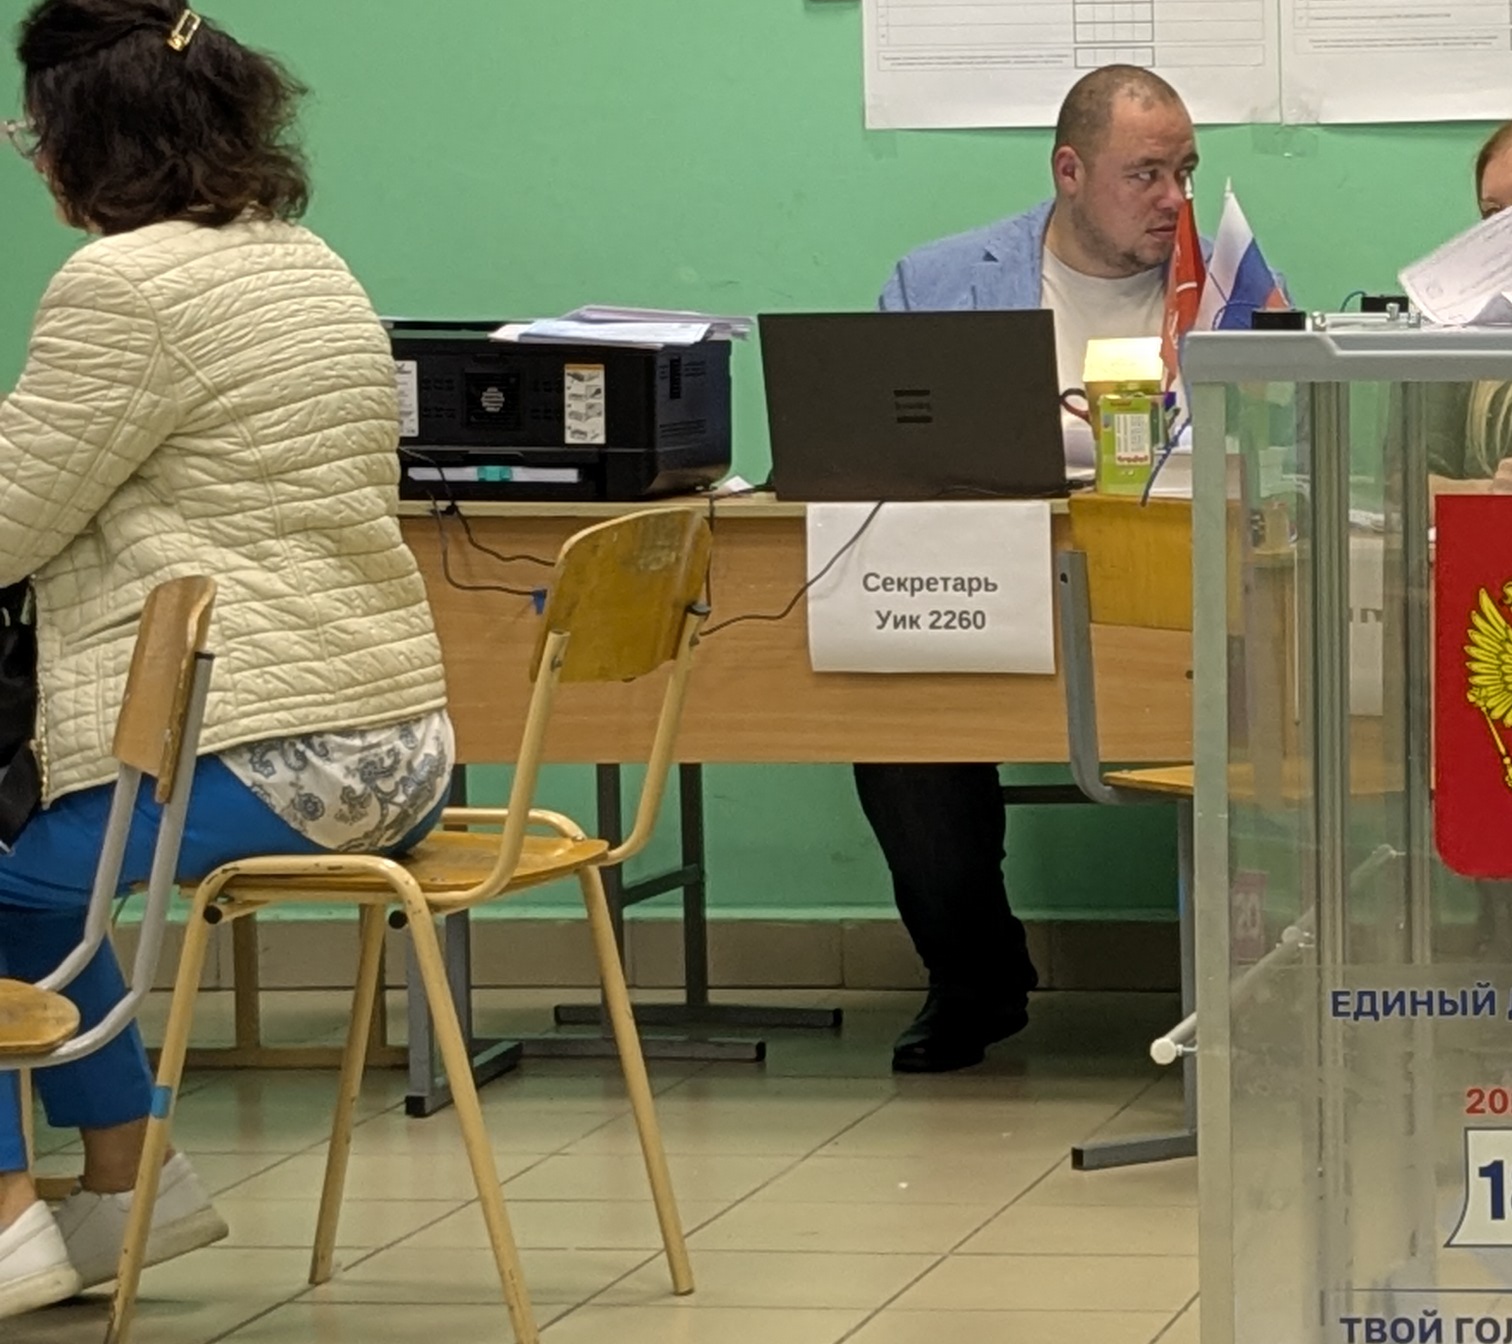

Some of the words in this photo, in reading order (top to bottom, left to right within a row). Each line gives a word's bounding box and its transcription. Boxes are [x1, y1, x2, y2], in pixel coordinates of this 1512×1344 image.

[862, 572, 999, 598] Секретарь
[875, 609, 922, 631] Уик
[928, 609, 986, 631] 2260
[1331, 982, 1497, 1021] ЕДИНЫЙ
[1339, 1309, 1443, 1344] ТВОЙ
